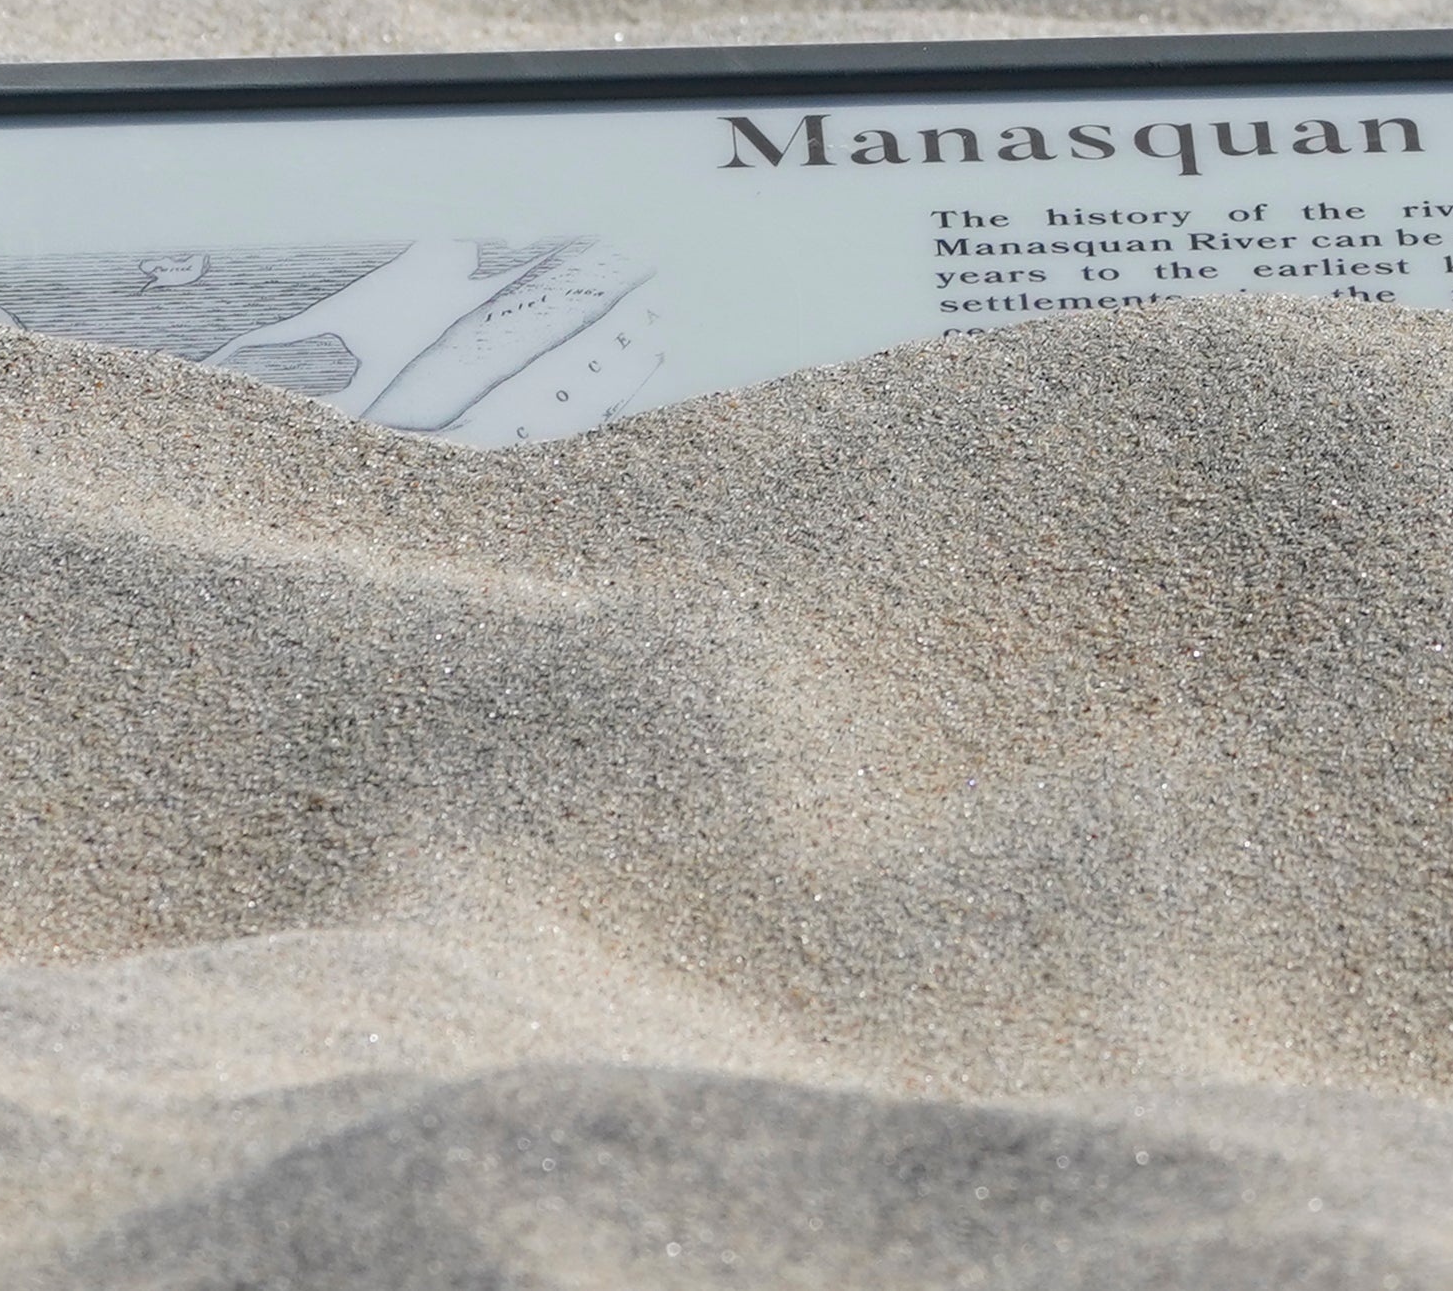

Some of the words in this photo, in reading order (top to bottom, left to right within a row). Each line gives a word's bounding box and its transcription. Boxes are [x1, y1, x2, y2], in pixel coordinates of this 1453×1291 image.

[715, 111, 1425, 176] Manasquan
[930, 209, 1010, 230] The
[1046, 207, 1192, 228] history
[1227, 203, 1269, 223] of
[1301, 201, 1366, 221] the
[933, 236, 1174, 258] Manasquan
[1186, 231, 1299, 251] River
[1311, 234, 1383, 249] can
[1395, 228, 1444, 247] be
[935, 269, 1048, 290] years
[1080, 265, 1121, 282] to
[1153, 260, 1219, 281] the
[1252, 257, 1410, 278] earliest
